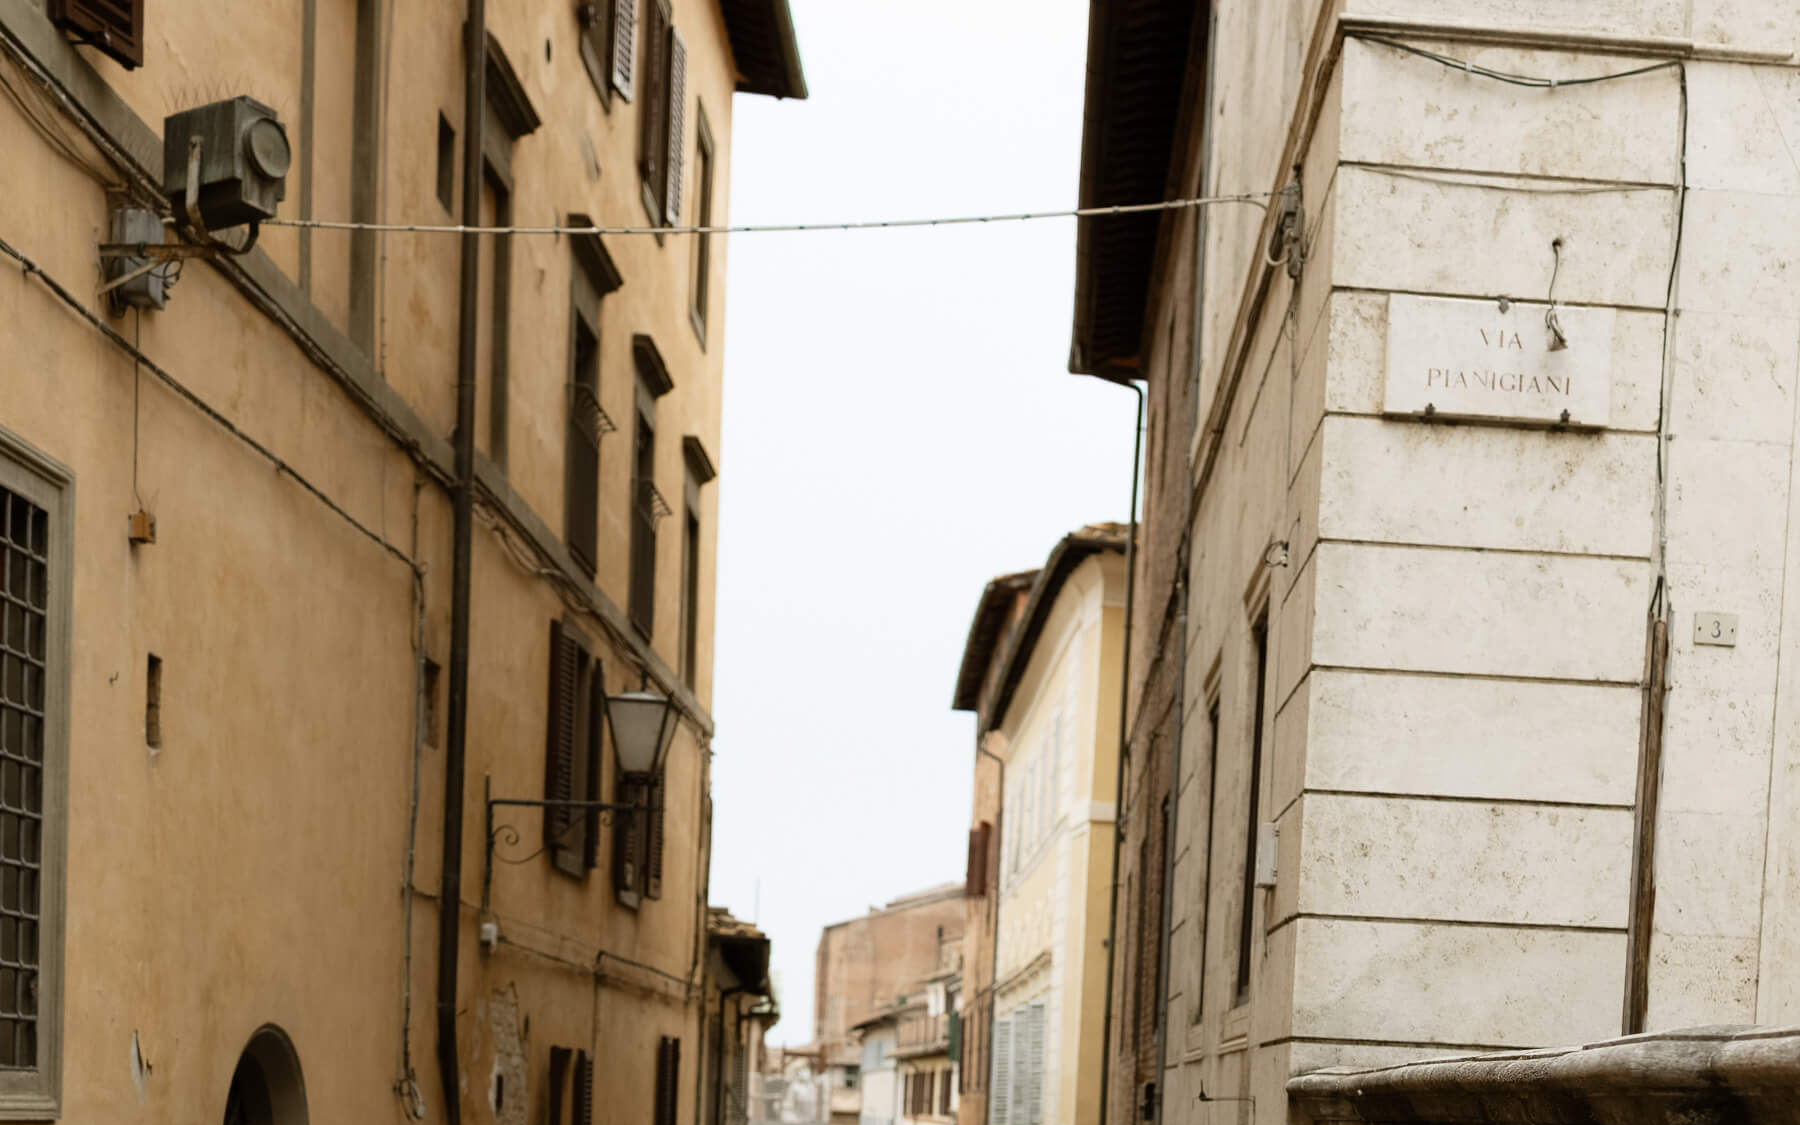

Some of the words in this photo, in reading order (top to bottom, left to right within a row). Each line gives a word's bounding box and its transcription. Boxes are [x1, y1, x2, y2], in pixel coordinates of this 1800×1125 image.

[1480, 328, 1523, 350] VIA
[1427, 367, 1571, 396] PIANIGIANI
[1711, 620, 1721, 639] 3
